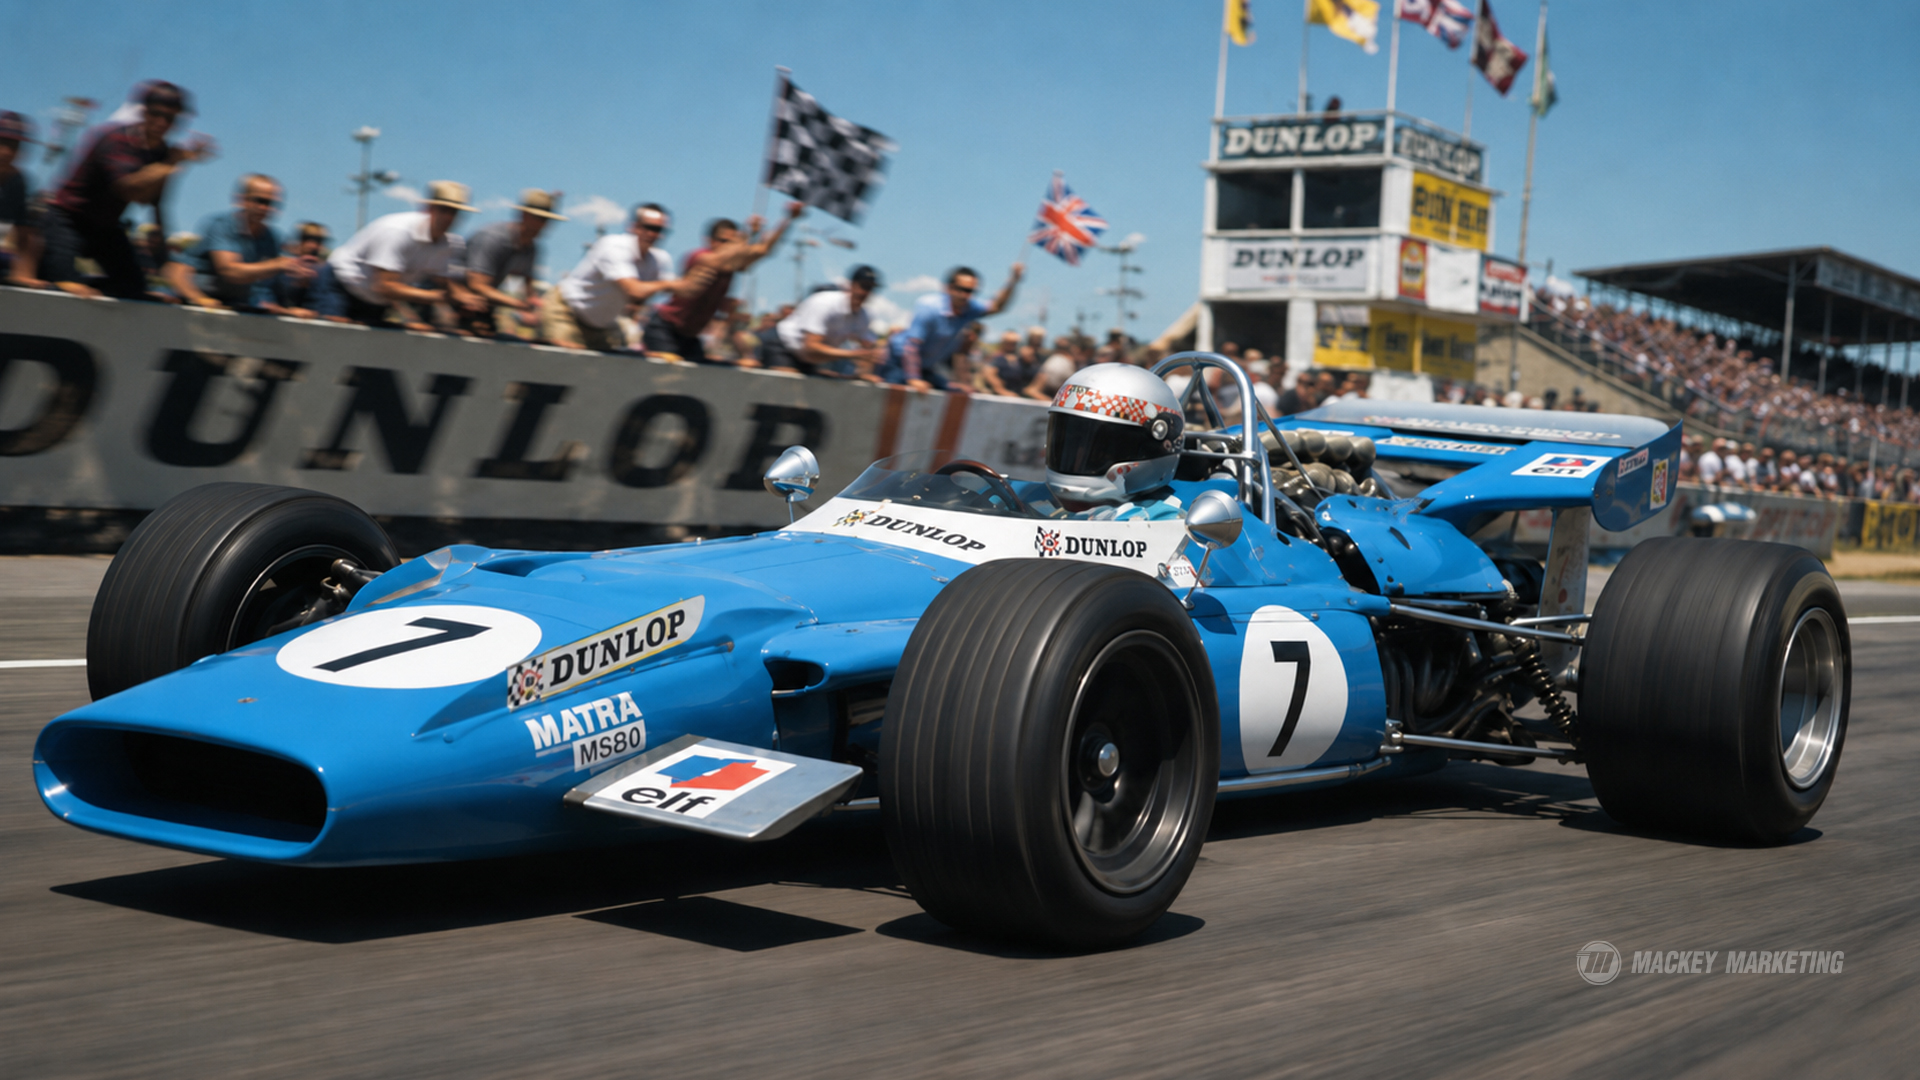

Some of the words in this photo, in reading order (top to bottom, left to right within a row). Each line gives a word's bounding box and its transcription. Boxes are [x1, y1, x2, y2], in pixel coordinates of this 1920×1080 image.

[1225, 122, 1378, 155] DUNLOP
[1233, 248, 1364, 269] DUNLOP
[0, 332, 832, 491] DUNLOP
[864, 514, 986, 551] DUNLOP
[1064, 536, 1148, 558] DUNLOP
[312, 616, 493, 673] 7
[550, 609, 685, 687] DUNLOP
[1266, 640, 1311, 757] 7
[524, 691, 643, 751] MATRA
[580, 726, 641, 766] MS80
[621, 786, 716, 814] elf
